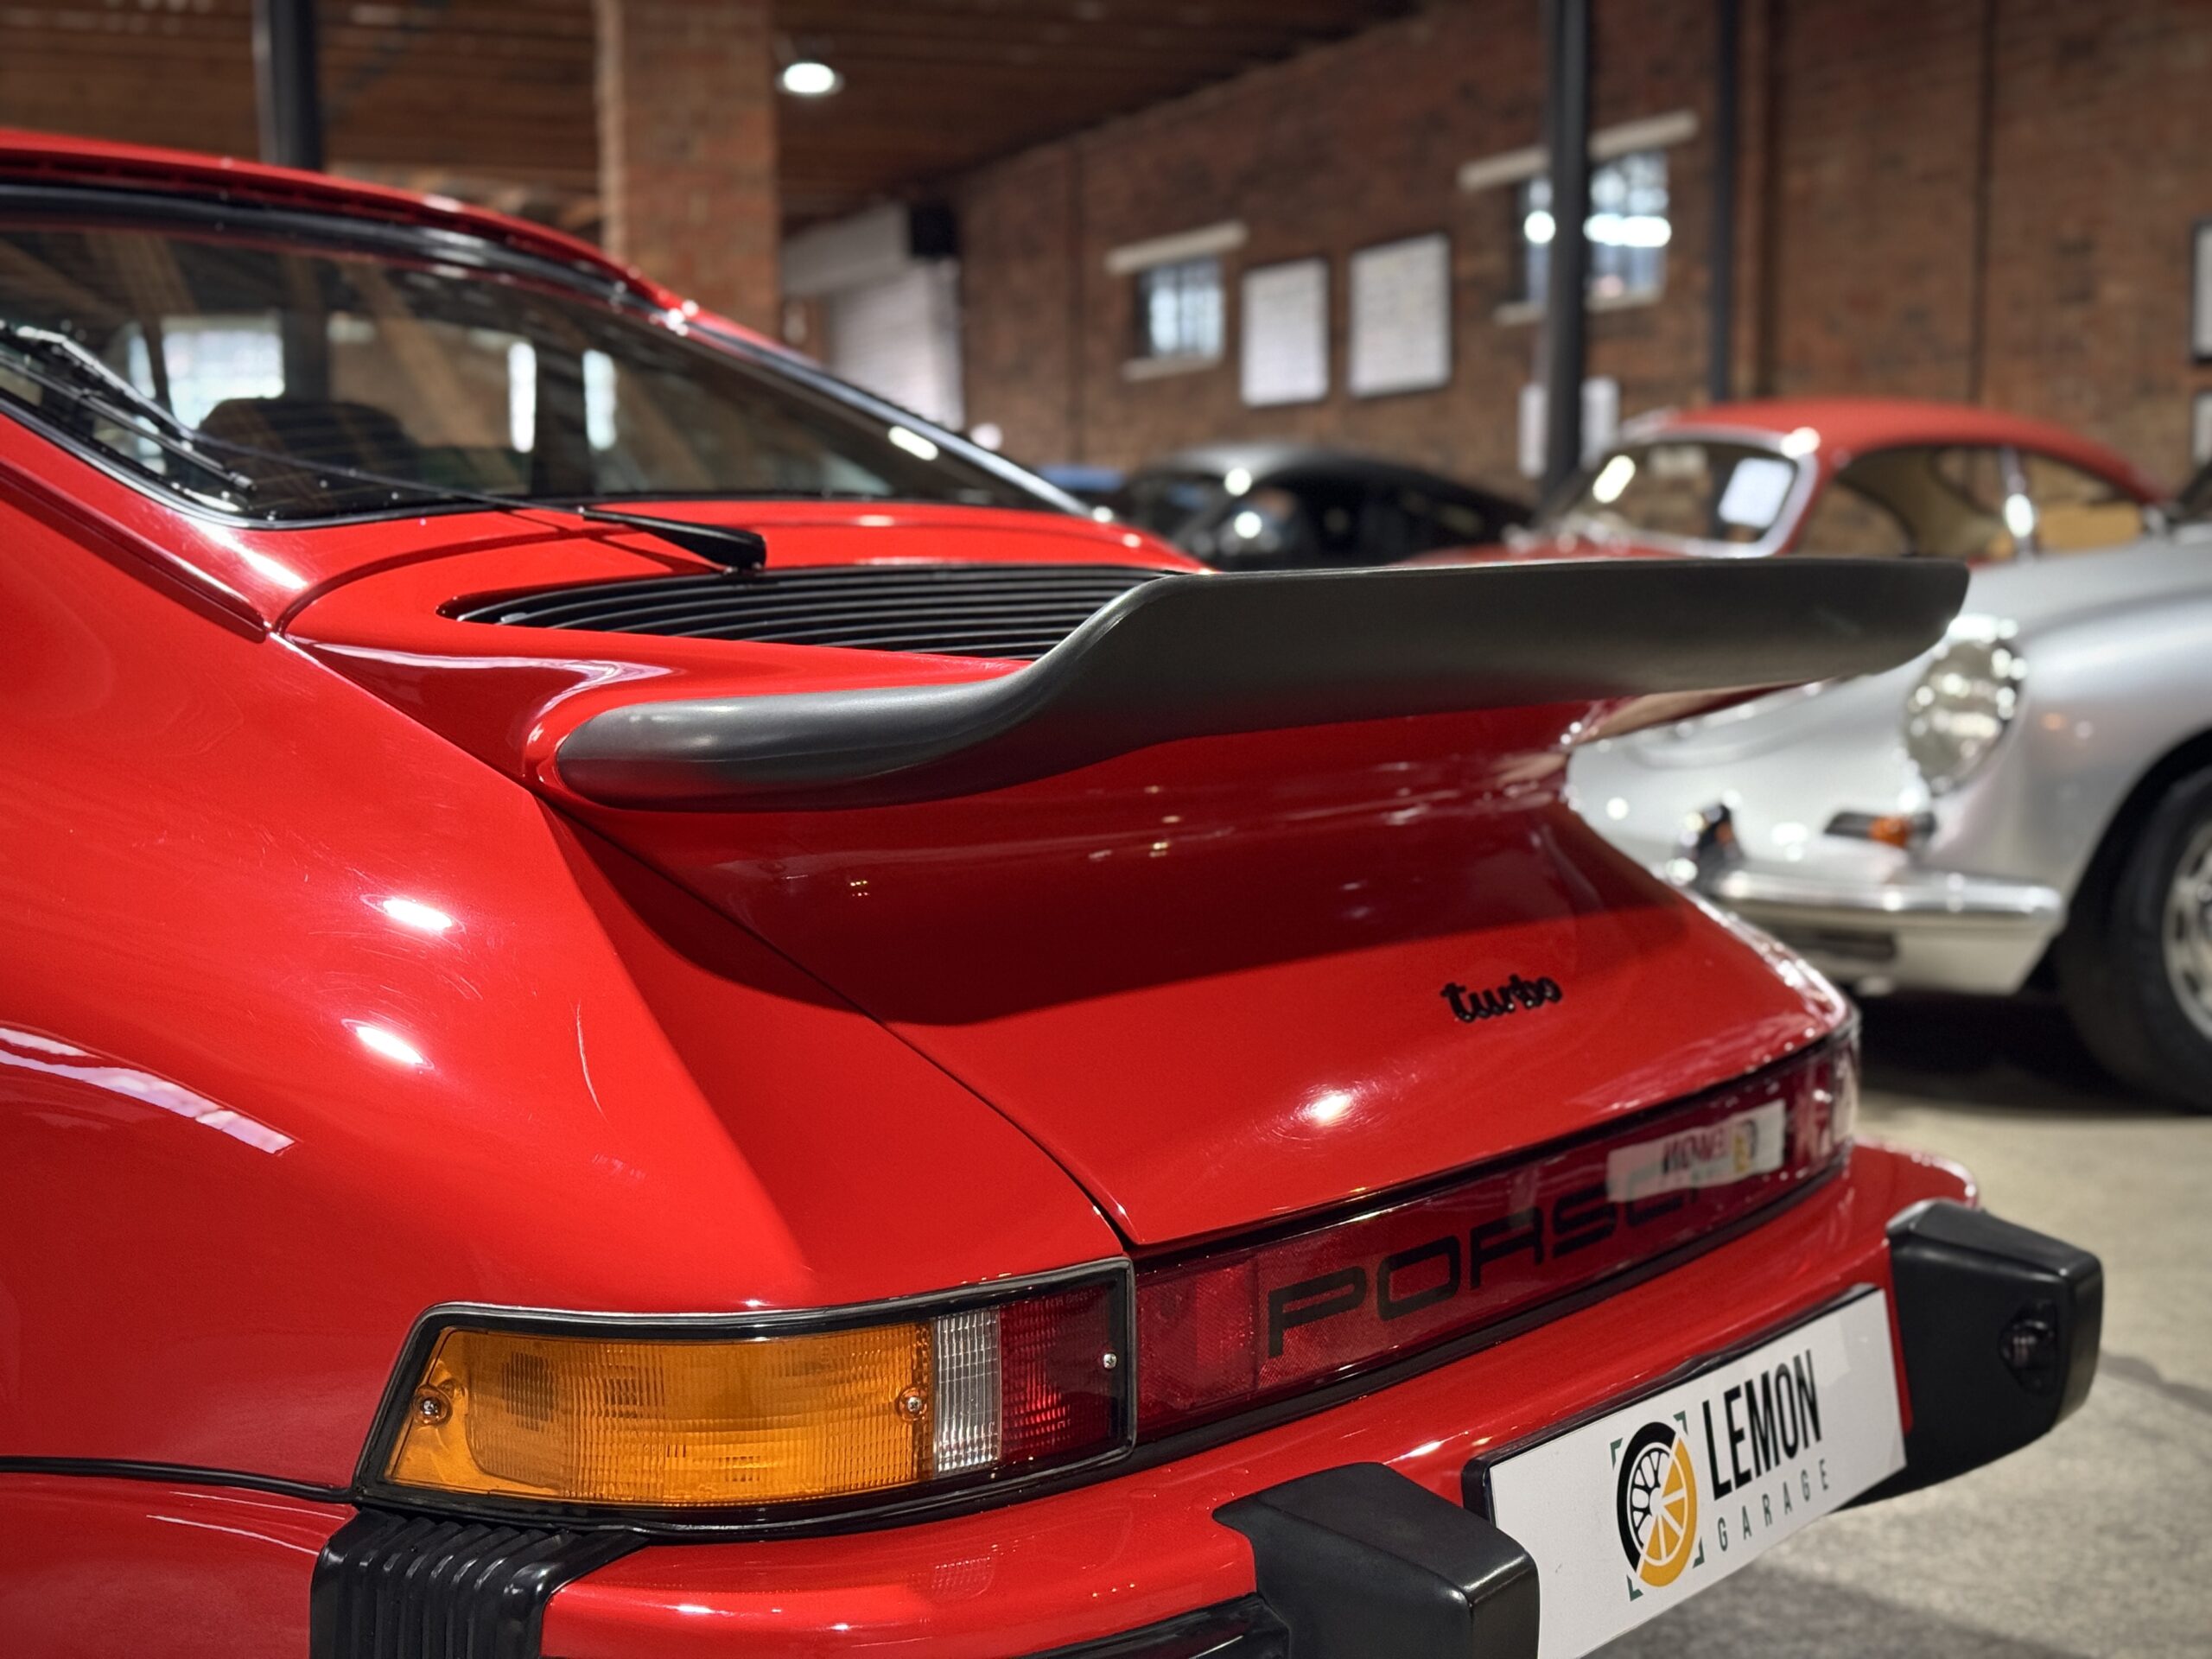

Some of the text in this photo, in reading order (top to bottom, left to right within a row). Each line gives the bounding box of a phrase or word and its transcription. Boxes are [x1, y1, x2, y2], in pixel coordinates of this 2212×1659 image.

[1440, 974, 1562, 1023] turbo
[1268, 1156, 1709, 1357] PORSC
[1702, 1350, 1821, 1501] LEMON
[1718, 1459, 1829, 1552] GARAGE
